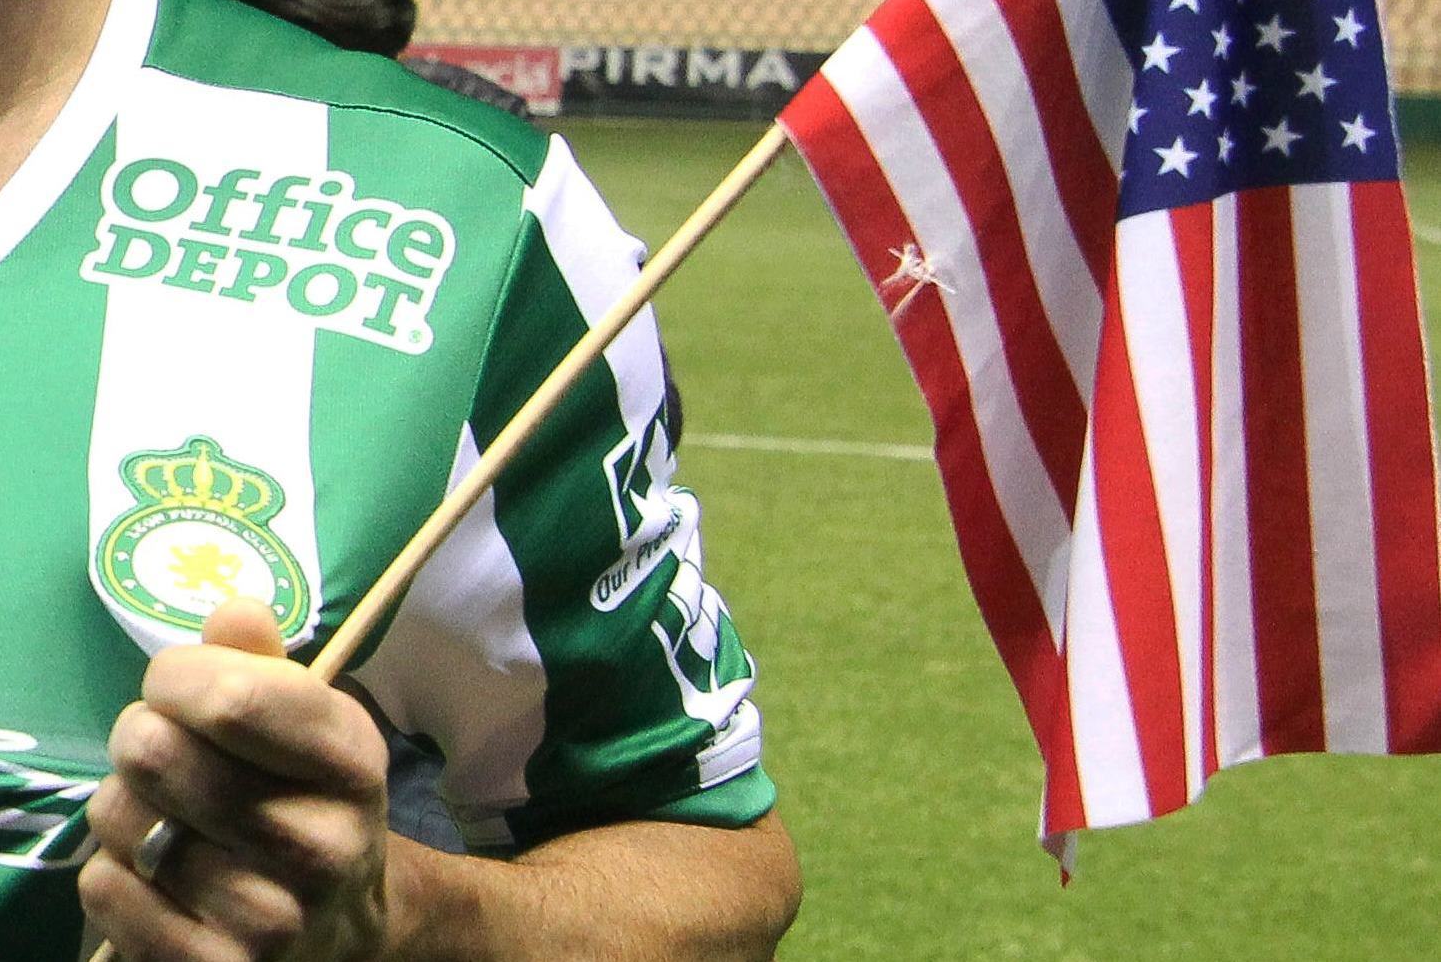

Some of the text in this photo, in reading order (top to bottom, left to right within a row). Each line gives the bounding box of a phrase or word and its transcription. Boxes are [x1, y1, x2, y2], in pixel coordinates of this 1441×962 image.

[562, 44, 800, 92] PIRMA
[111, 157, 446, 279] Office
[92, 223, 425, 336] DEPOT
